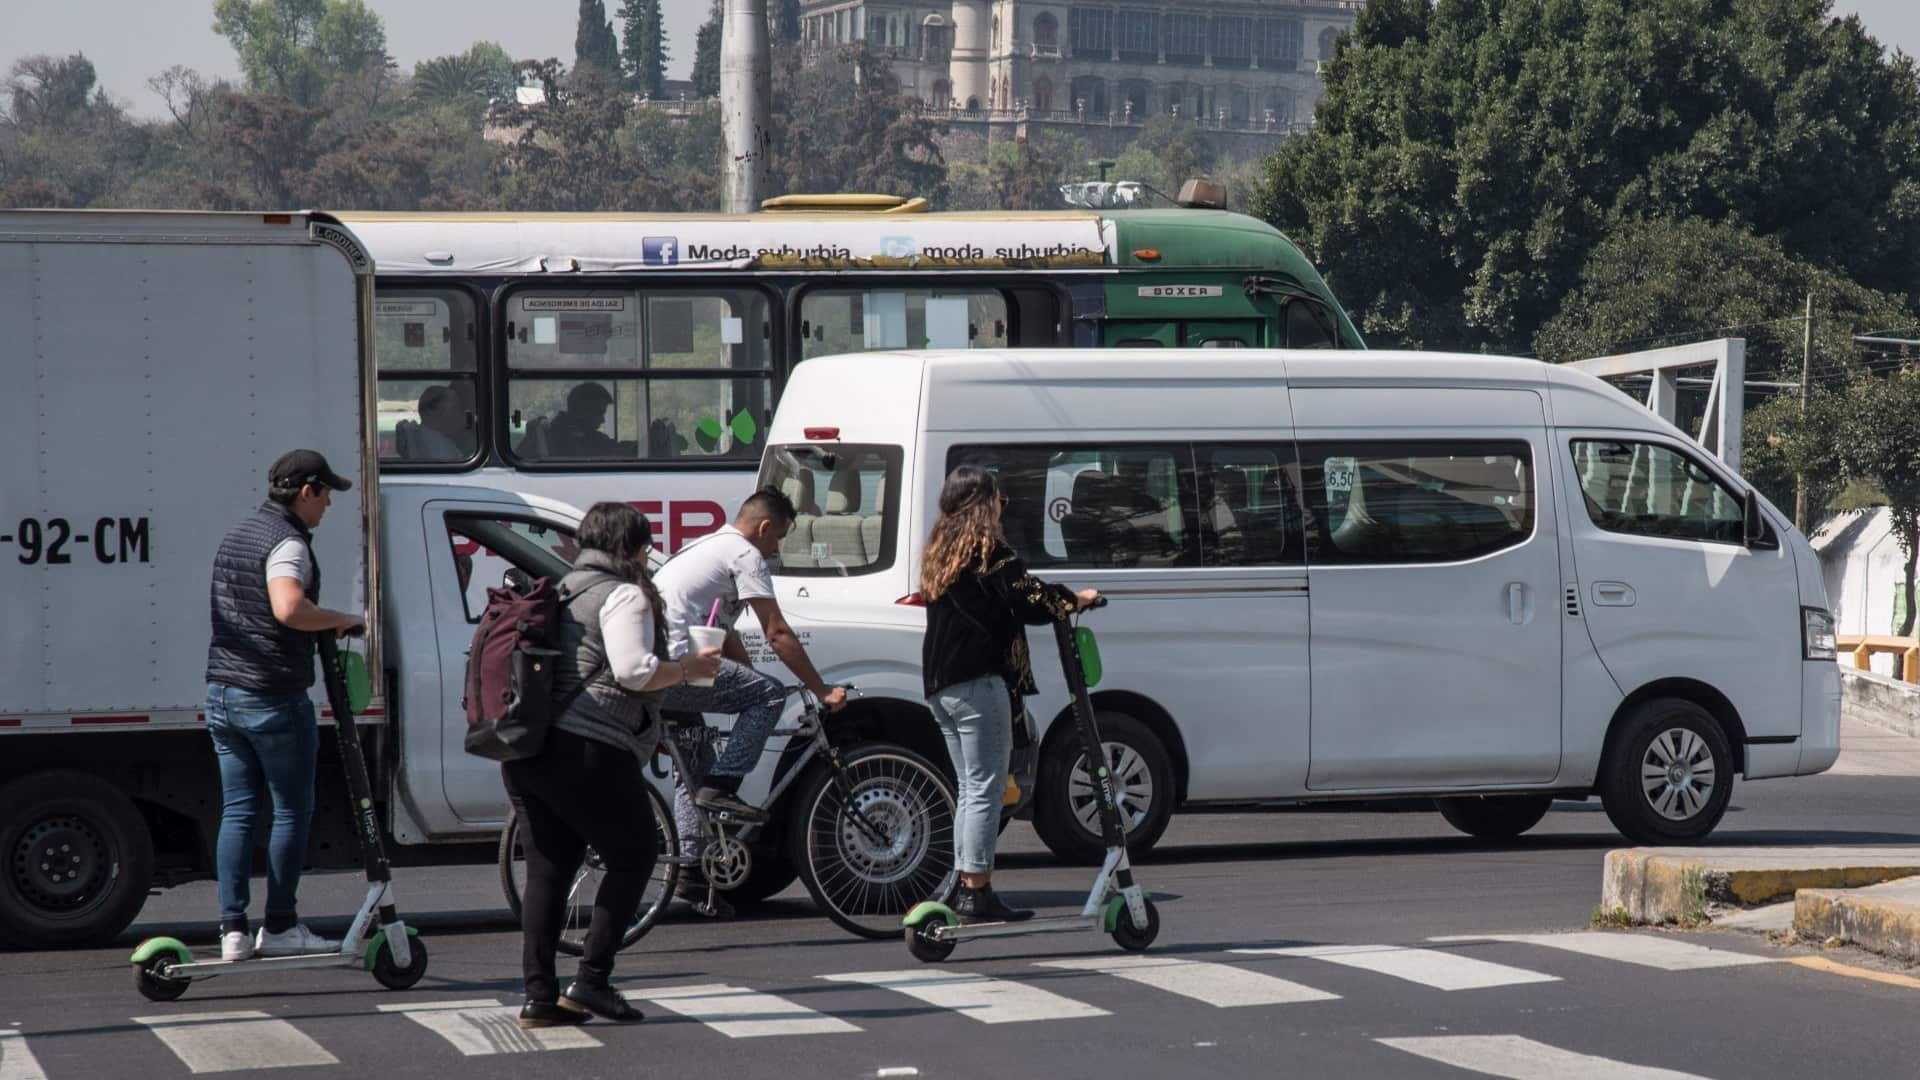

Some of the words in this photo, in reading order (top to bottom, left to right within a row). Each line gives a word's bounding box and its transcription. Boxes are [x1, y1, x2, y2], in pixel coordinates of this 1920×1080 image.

[688, 244, 751, 261] Moda
[923, 243, 984, 259] moda
[1154, 287, 1208, 296] BOXER
